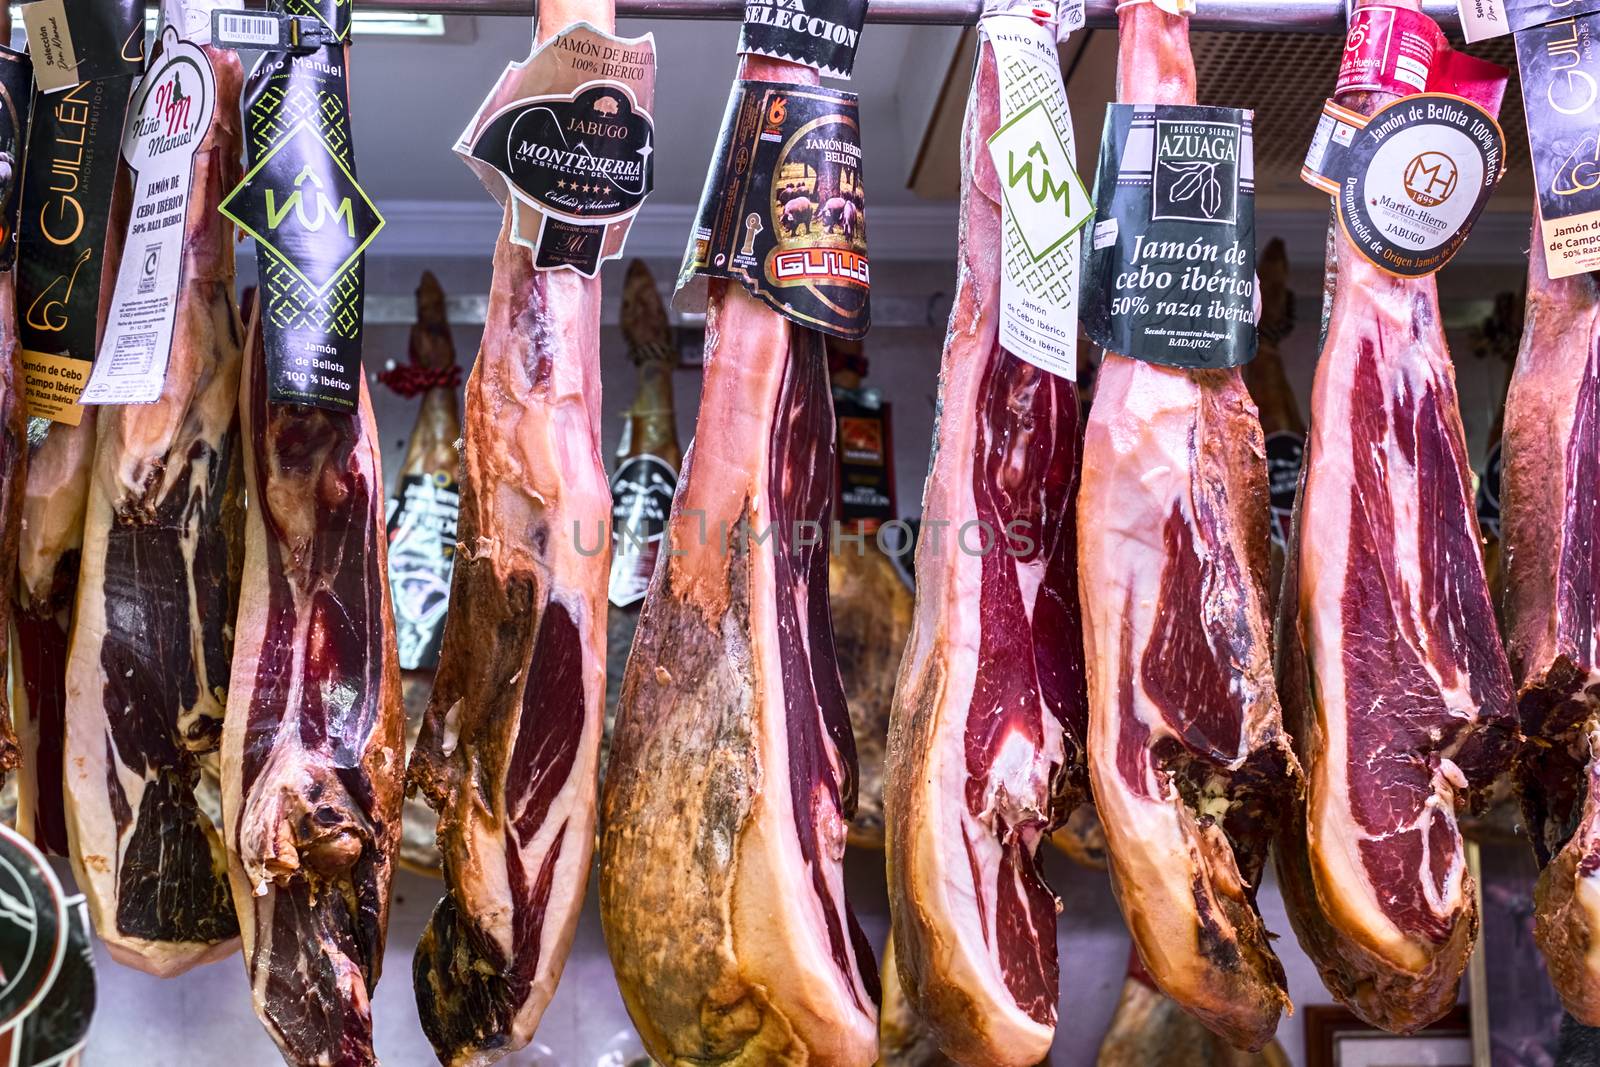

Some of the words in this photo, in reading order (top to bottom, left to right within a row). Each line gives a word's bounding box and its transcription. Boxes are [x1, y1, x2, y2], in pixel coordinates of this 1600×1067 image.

[743, 6, 859, 49] SELECCION
[40, 26, 54, 66] Selección
[553, 35, 601, 57] JAMÓN
[602, 47, 620, 61] DE
[997, 33, 1032, 46] Niño
[1580, 22, 1593, 63] JAMONES
[251, 59, 285, 81] Niño
[291, 56, 342, 78] Manuel
[571, 57, 598, 74] 100%
[600, 62, 645, 81] IBÉRICO
[1544, 16, 1598, 115] GUILL
[133, 116, 161, 139] Niño
[567, 117, 628, 140] JABUGO
[1170, 124, 1206, 134] IBÉRICO
[1208, 128, 1235, 138] SIERRA
[148, 122, 194, 158] Manuel
[805, 137, 842, 152] JAMÓN
[1158, 135, 1236, 162] AZUAGA
[1369, 113, 1409, 144] Jamón
[1408, 105, 1424, 121] de
[1427, 103, 1469, 127] Bellota
[1469, 118, 1493, 151] 100%
[1484, 146, 1499, 187] Ibérico
[40, 80, 92, 246] GUILLÉN
[515, 153, 527, 162] LA
[532, 158, 585, 176] ESTRELLA
[590, 171, 607, 179] DEL
[516, 140, 640, 176] MONTESIERRA
[824, 151, 858, 168] BELLOTA
[146, 177, 171, 198] JAMÓN
[170, 174, 180, 189] DE
[136, 202, 156, 219] CEBO
[156, 193, 184, 215] IBÉRICO
[544, 190, 580, 207] Calidad
[1411, 191, 1435, 206] 1899
[1346, 176, 1372, 245] Denominación
[1369, 240, 1384, 255] de
[1382, 248, 1413, 267] Origen
[1379, 194, 1448, 230] Martín-Hierro
[131, 222, 147, 235] 50%
[147, 218, 162, 232] RAZA
[1385, 223, 1426, 245] JABUGO
[1554, 223, 1589, 238] Jamón
[1591, 220, 1600, 230] d
[1130, 235, 1218, 265] Jamón
[1224, 240, 1247, 266] de
[1549, 242, 1563, 252] de
[1563, 249, 1581, 259] 50%
[1115, 264, 1173, 290] cebo
[1180, 266, 1253, 298] ibérico
[1021, 298, 1047, 317] Jamón
[1110, 296, 1150, 316] 50%
[1155, 301, 1203, 317] raza
[1207, 300, 1254, 325] ibérica
[1007, 303, 1015, 314] de
[1016, 308, 1035, 325] Cebo
[1037, 319, 1066, 338] Ibérico
[1007, 320, 1019, 335] 50%
[1020, 330, 1037, 345] Raza
[1038, 339, 1066, 357] Ibérica
[1144, 327, 1167, 336] Secado
[1175, 330, 1202, 338] nuestras
[1202, 330, 1225, 341] bodegas
[1168, 338, 1212, 350] BADAJOZ
[304, 341, 337, 356] Jamón
[48, 365, 59, 376] de
[60, 367, 82, 381] Cebo
[295, 357, 309, 367] de
[312, 358, 345, 373] Bellota
[25, 375, 54, 390] Campo
[285, 371, 307, 382] 100
[309, 373, 319, 384] %
[321, 376, 351, 391] Ibérico
[36, 390, 51, 400] Raza
[51, 393, 74, 405] Ibérica
